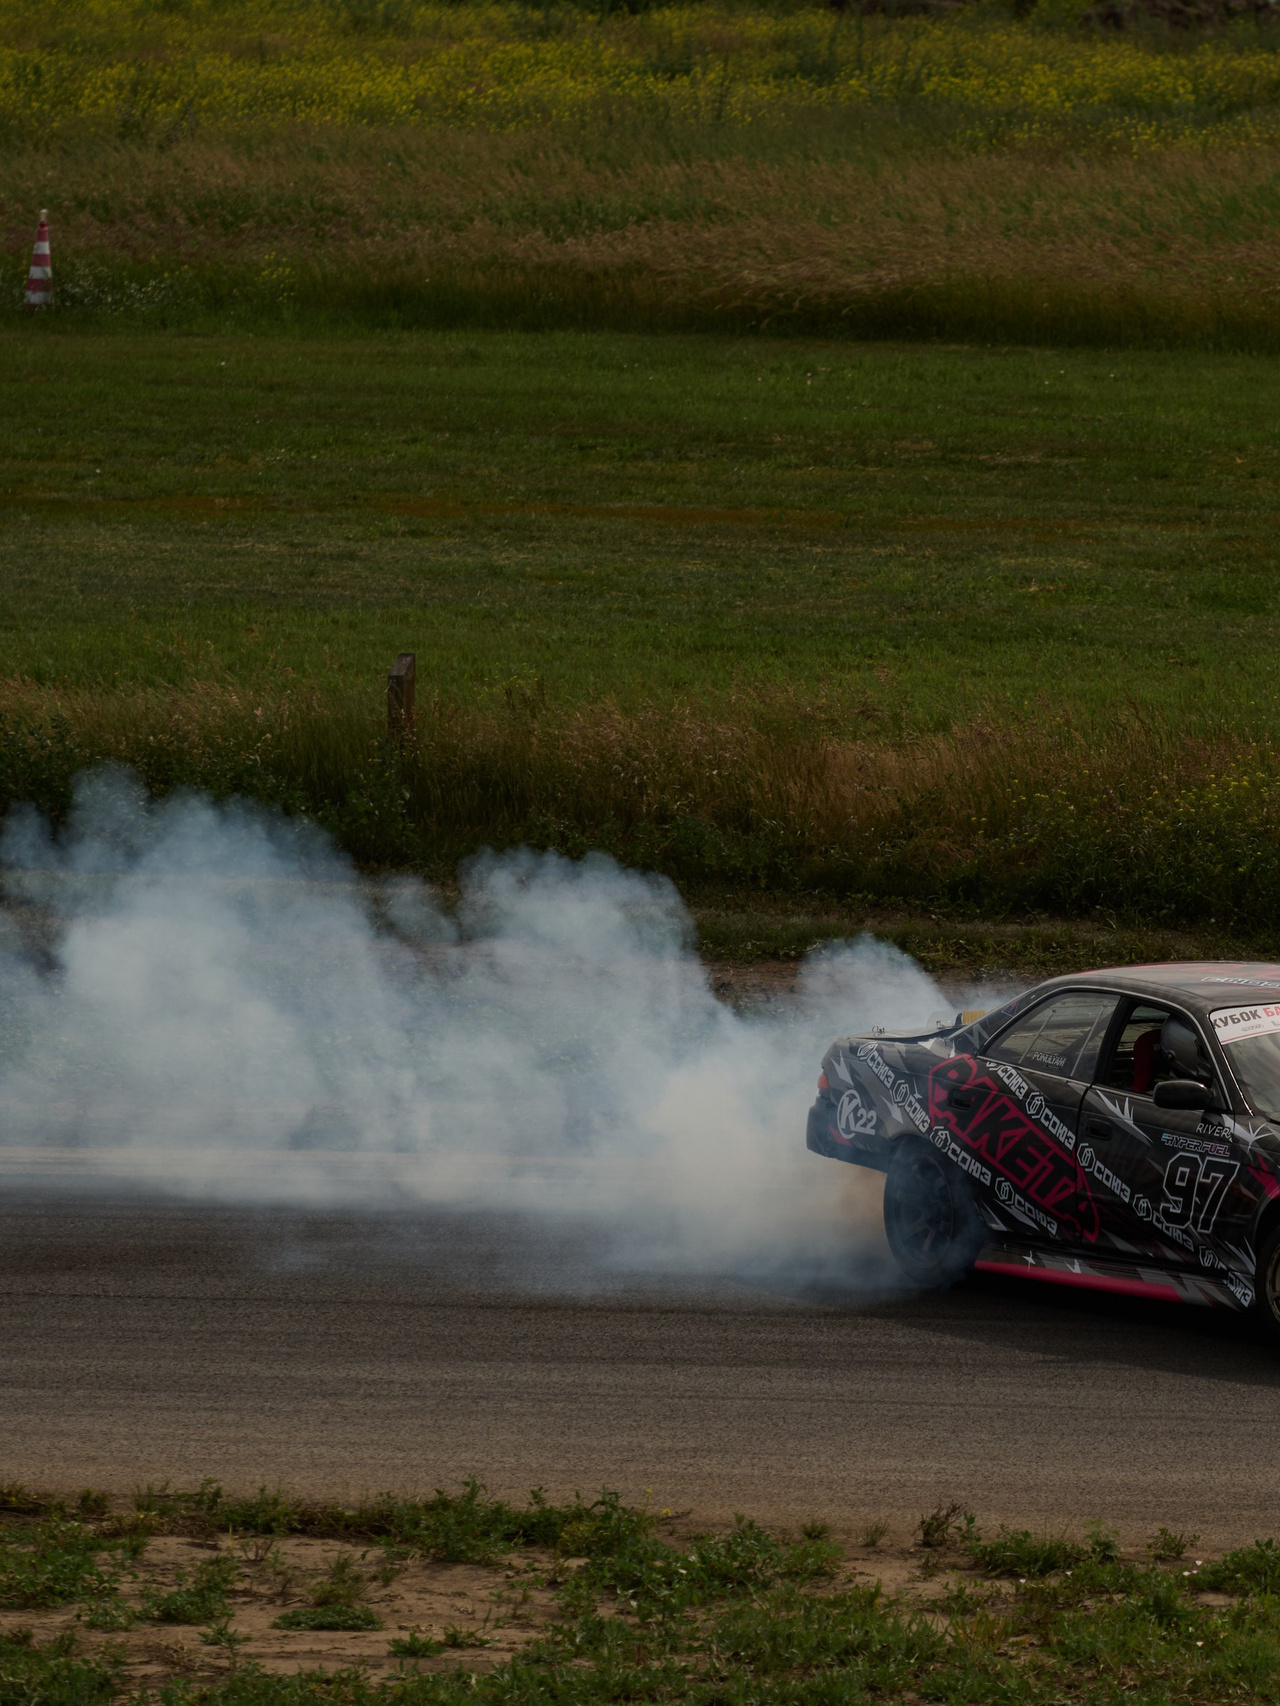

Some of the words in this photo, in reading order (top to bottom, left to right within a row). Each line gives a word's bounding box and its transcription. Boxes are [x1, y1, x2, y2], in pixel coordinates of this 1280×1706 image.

[1211, 1009, 1262, 1030] КУБОК
[1040, 1107, 1076, 1151] СОЮЗ
[947, 1142, 992, 1187] СОЮЗ
[1094, 1160, 1131, 1204] СОЮЗ
[1014, 1193, 1058, 1236] СОЮЗ
[1160, 1152, 1240, 1234] 97
